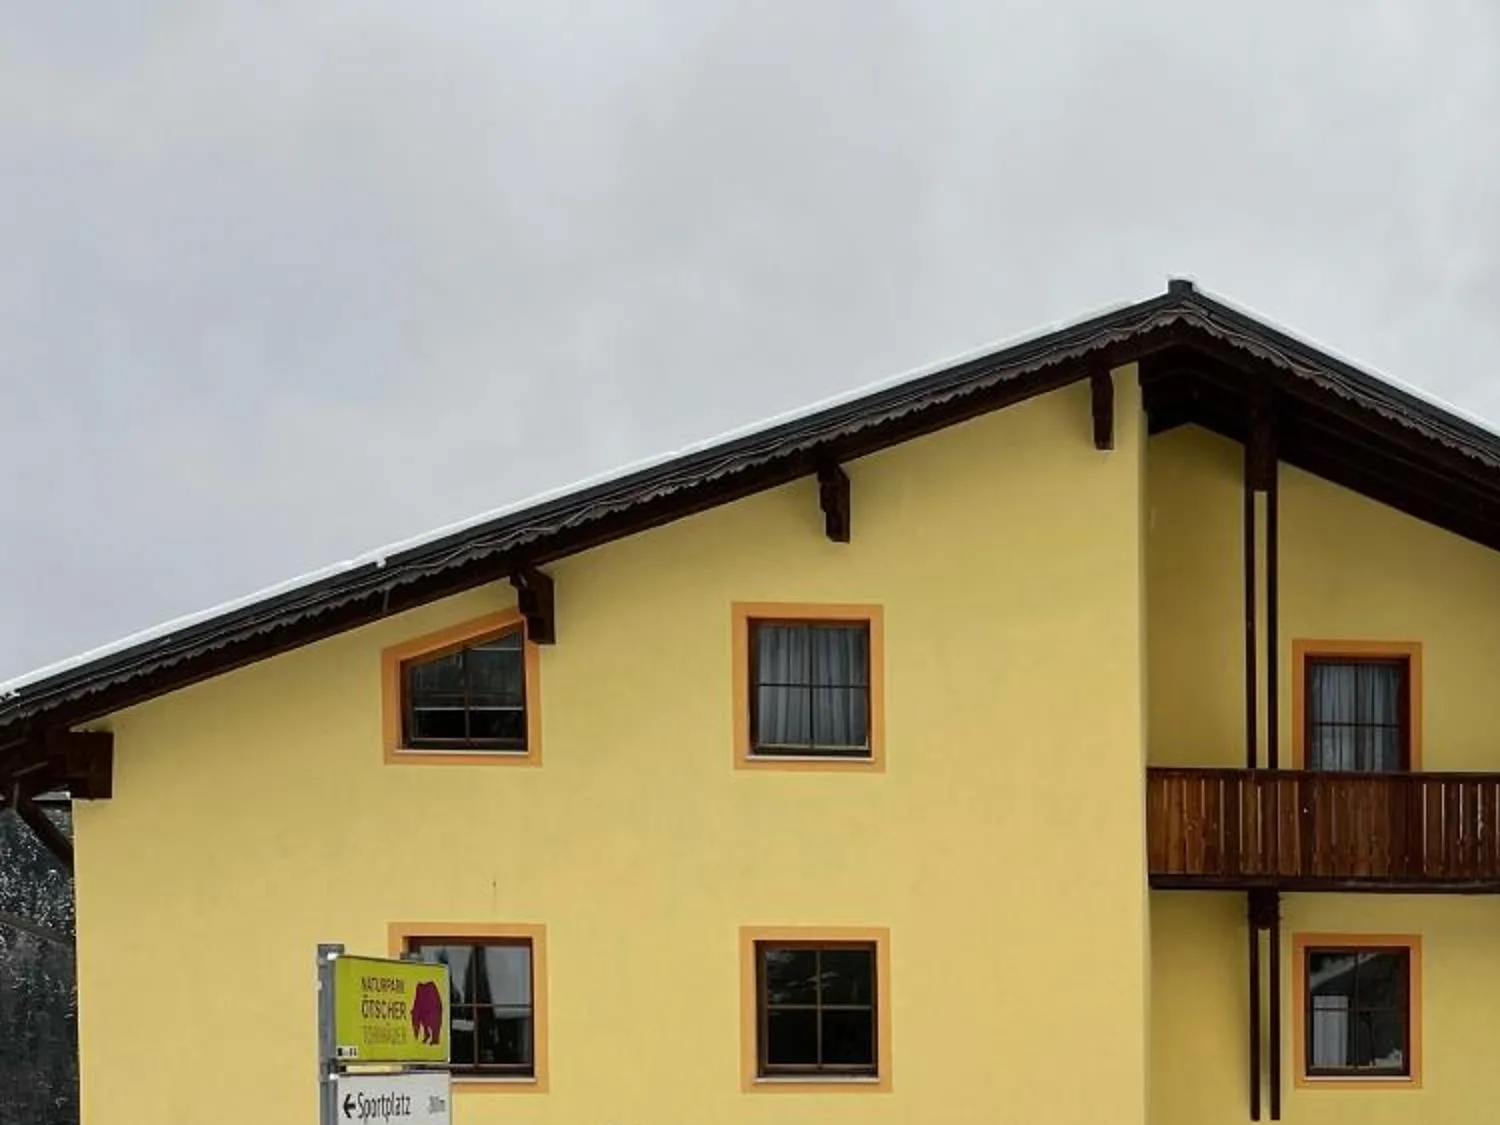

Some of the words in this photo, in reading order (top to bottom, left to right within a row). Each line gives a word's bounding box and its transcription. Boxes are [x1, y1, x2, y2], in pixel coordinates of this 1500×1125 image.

[361, 976, 405, 994] NATURPARK
[361, 994, 407, 1020] ÖTSCHER
[358, 1091, 411, 1124] Sportplatz
